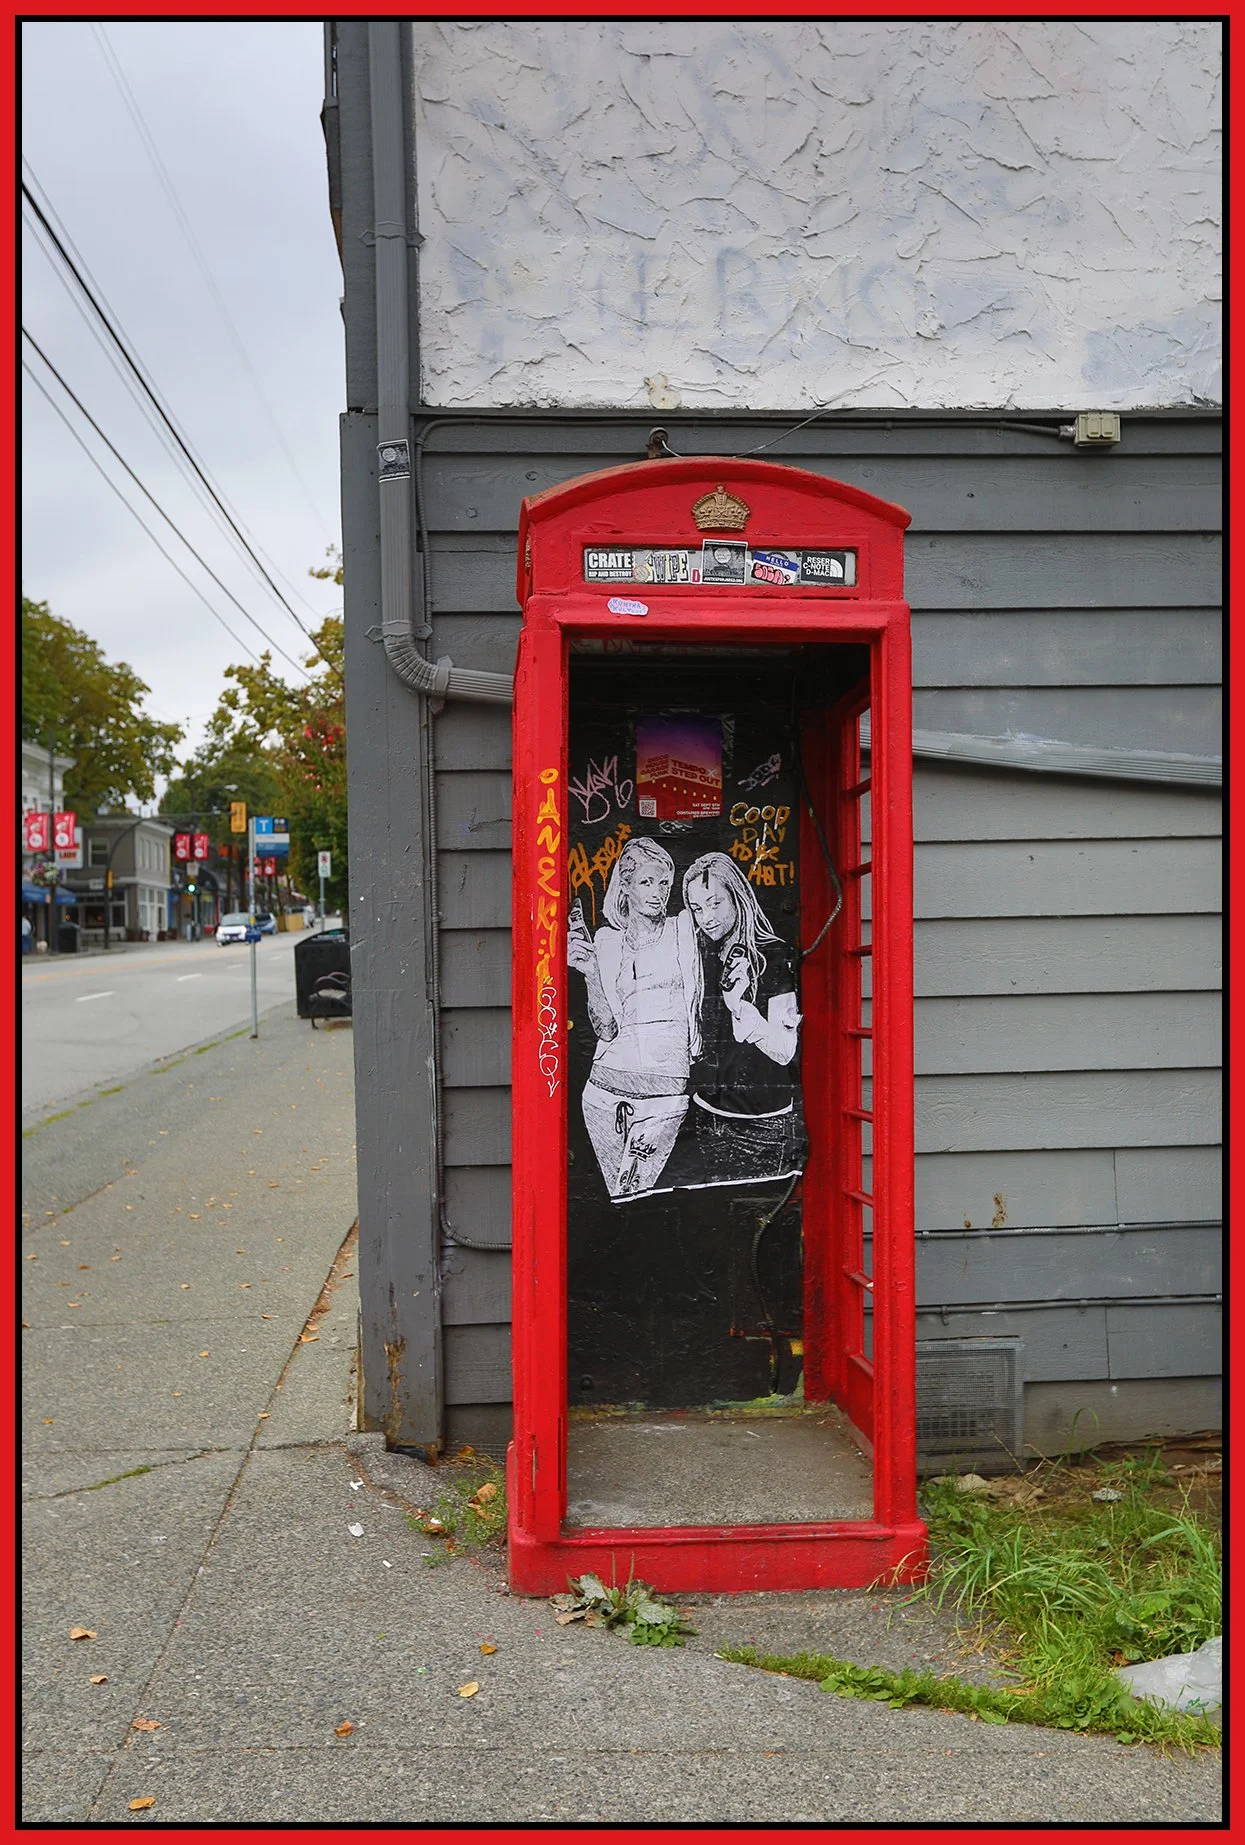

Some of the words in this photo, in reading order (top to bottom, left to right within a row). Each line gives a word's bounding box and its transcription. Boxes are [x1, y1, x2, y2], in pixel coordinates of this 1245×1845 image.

[588, 553, 632, 568] CRATE
[765, 556, 789, 567] HELLO
[806, 557, 830, 565] RESER
[802, 562, 830, 571] C-NOTE
[805, 568, 830, 577] D-MAC
[645, 759, 669, 768] HOUSE
[672, 759, 706, 775] TEMPO
[640, 764, 669, 775] GARAGE
[650, 770, 669, 778] FUNK
[671, 767, 697, 779] STEP
[699, 775, 721, 786] OUT
[259, 819, 269, 833] T
[743, 823, 786, 844] DAY
